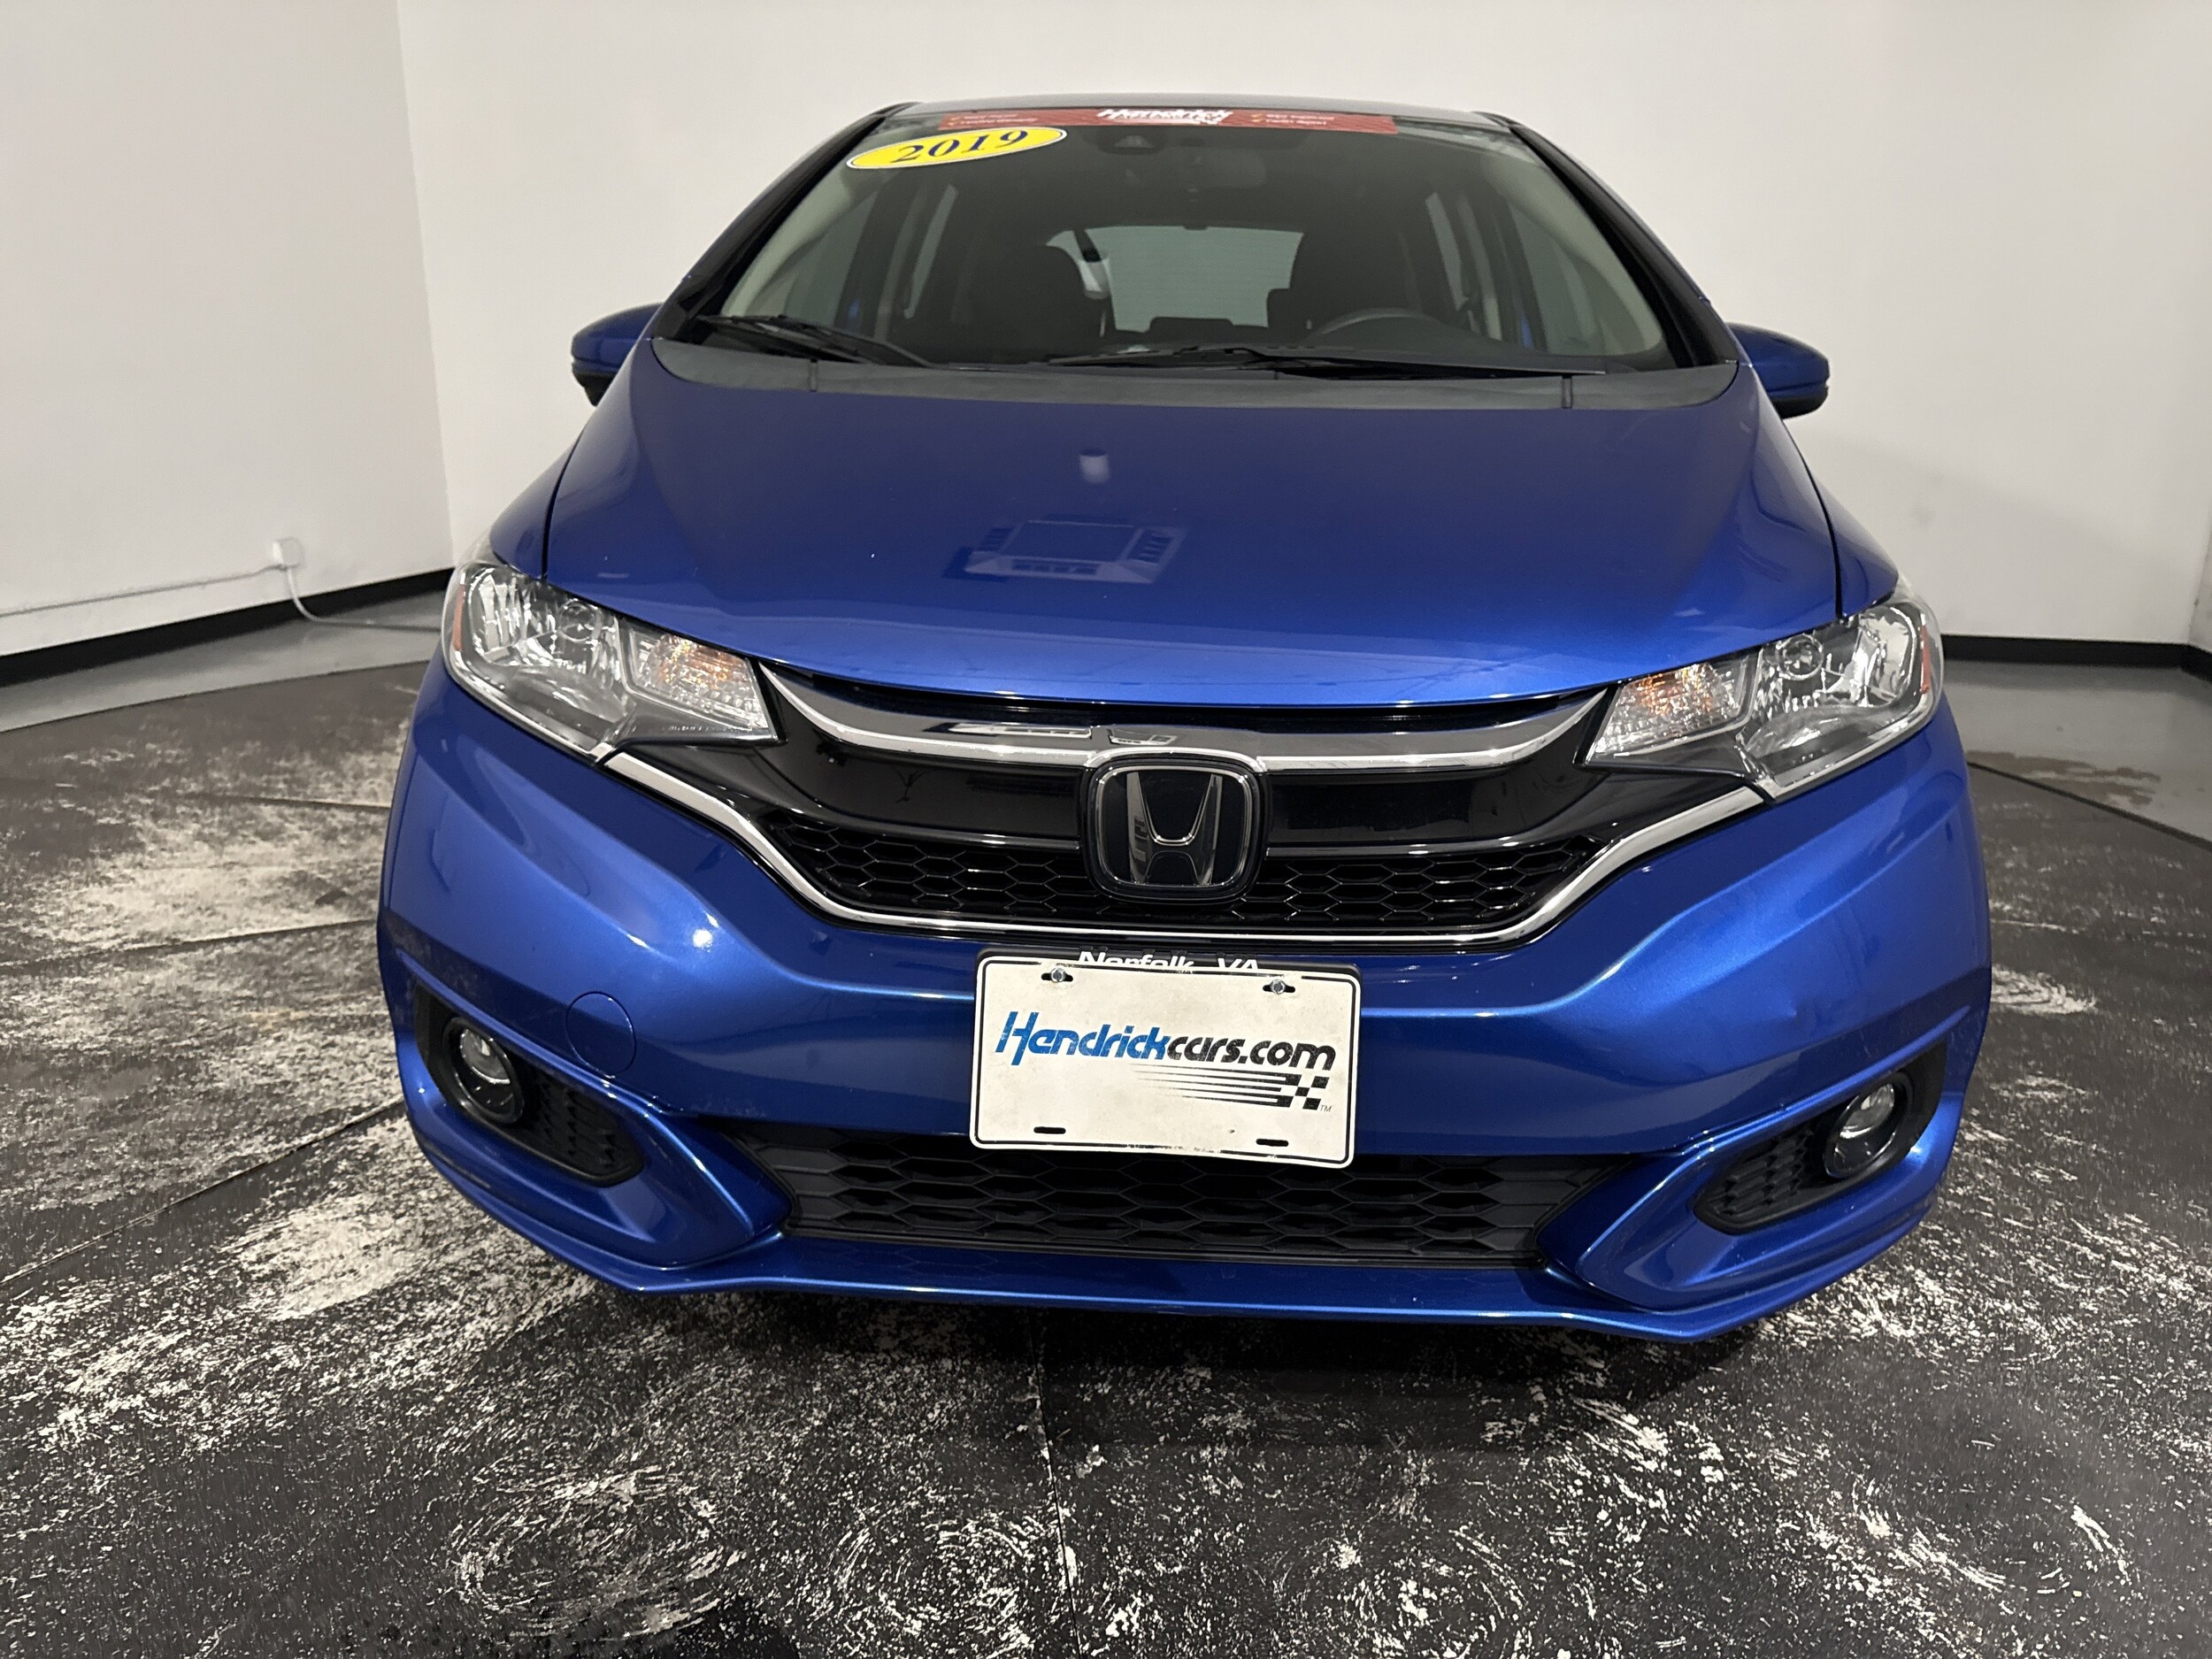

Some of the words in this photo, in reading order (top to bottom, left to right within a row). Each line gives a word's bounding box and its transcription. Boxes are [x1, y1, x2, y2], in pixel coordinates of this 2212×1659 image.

[890, 130, 1029, 163] 2019
[995, 1010, 1337, 1071] Hendrickcars.com
[1319, 1104, 1333, 1113] TM
